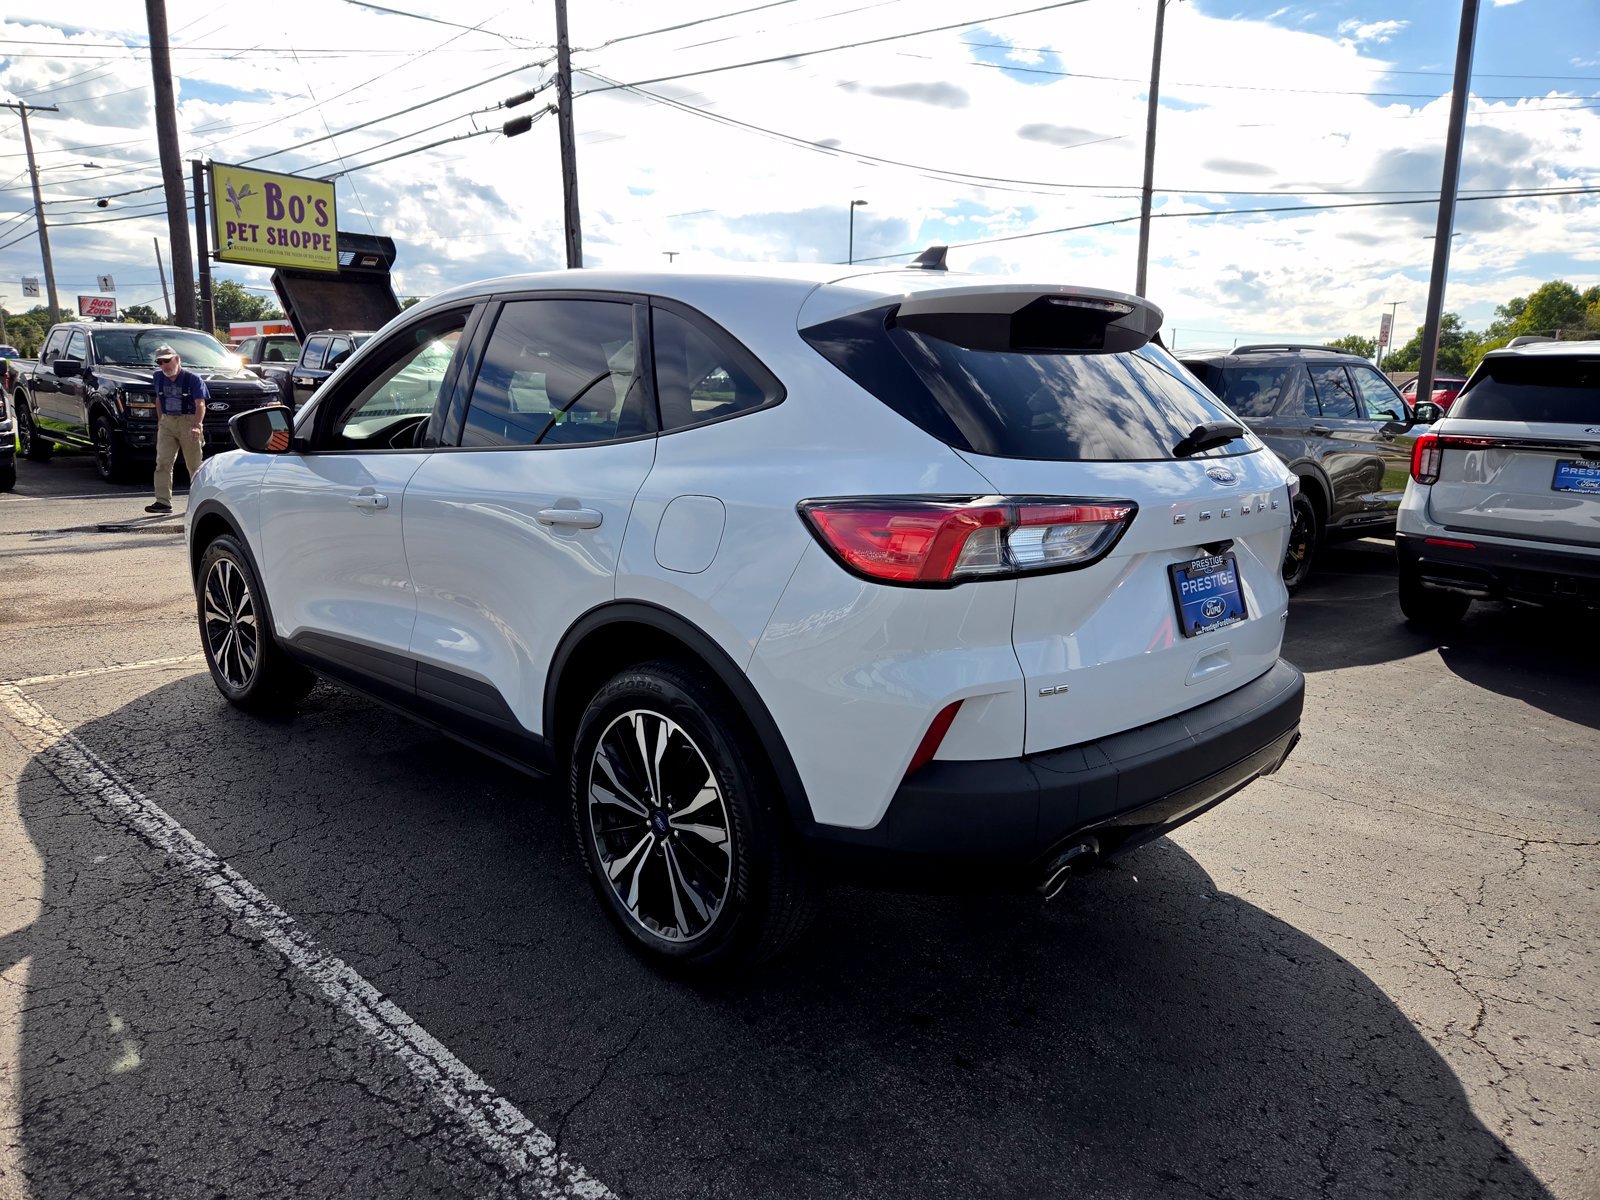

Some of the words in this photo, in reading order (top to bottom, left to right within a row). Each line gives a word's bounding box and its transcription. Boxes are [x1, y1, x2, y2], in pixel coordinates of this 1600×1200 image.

[226, 221, 259, 243] PET
[267, 226, 332, 252] SHOPPE
[86, 306, 111, 315] Zone
[90, 298, 113, 307] Auto
[1173, 500, 1279, 525] ESCAPE
[1191, 555, 1224, 570] PRESTIGE
[1181, 571, 1234, 596] PRESTIGE
[1205, 599, 1222, 616] Ford
[1039, 684, 1069, 697] SE
